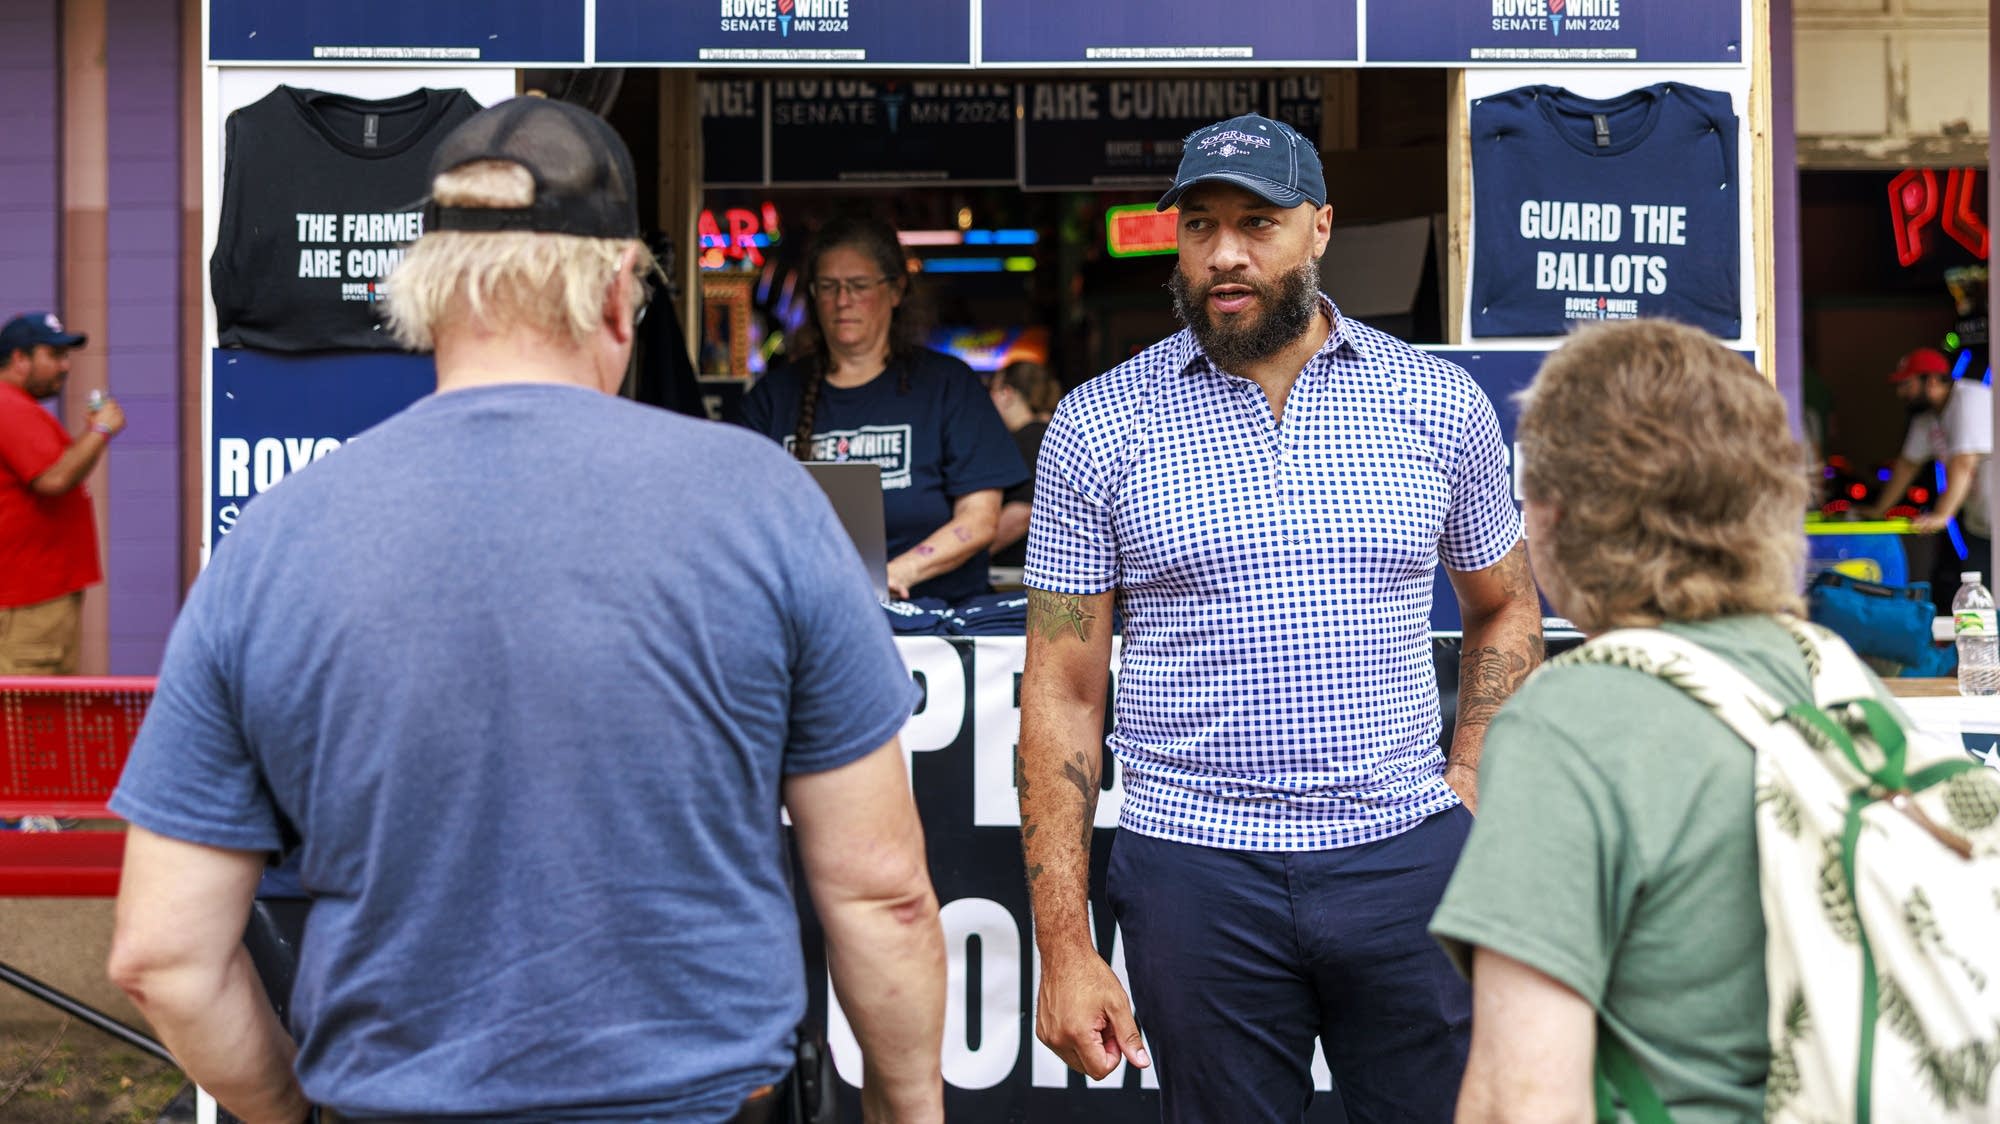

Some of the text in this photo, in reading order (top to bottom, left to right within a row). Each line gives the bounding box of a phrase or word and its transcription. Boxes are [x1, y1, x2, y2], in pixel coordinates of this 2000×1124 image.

[721, 0, 849, 18] ROYCE WHITE
[1492, 0, 1620, 17] ROYCE WHITE
[720, 19, 849, 32] SENATE MN 2024
[1492, 18, 1620, 31] SENATE MN 2024
[1032, 79, 1099, 120] ARE
[775, 100, 1010, 125] SENATE MN 2024
[1197, 130, 1271, 149] SOVEREIGN
[296, 213, 337, 243] THE
[1520, 199, 1687, 246] GUARD THE
[298, 249, 342, 278] ARE
[1536, 250, 1668, 295] BALLOTS
[1565, 297, 1638, 314] ROYCE WHITE
[1565, 311, 1598, 320] SENATE
[850, 432, 902, 457] WHITE
[219, 437, 360, 497] ROY
